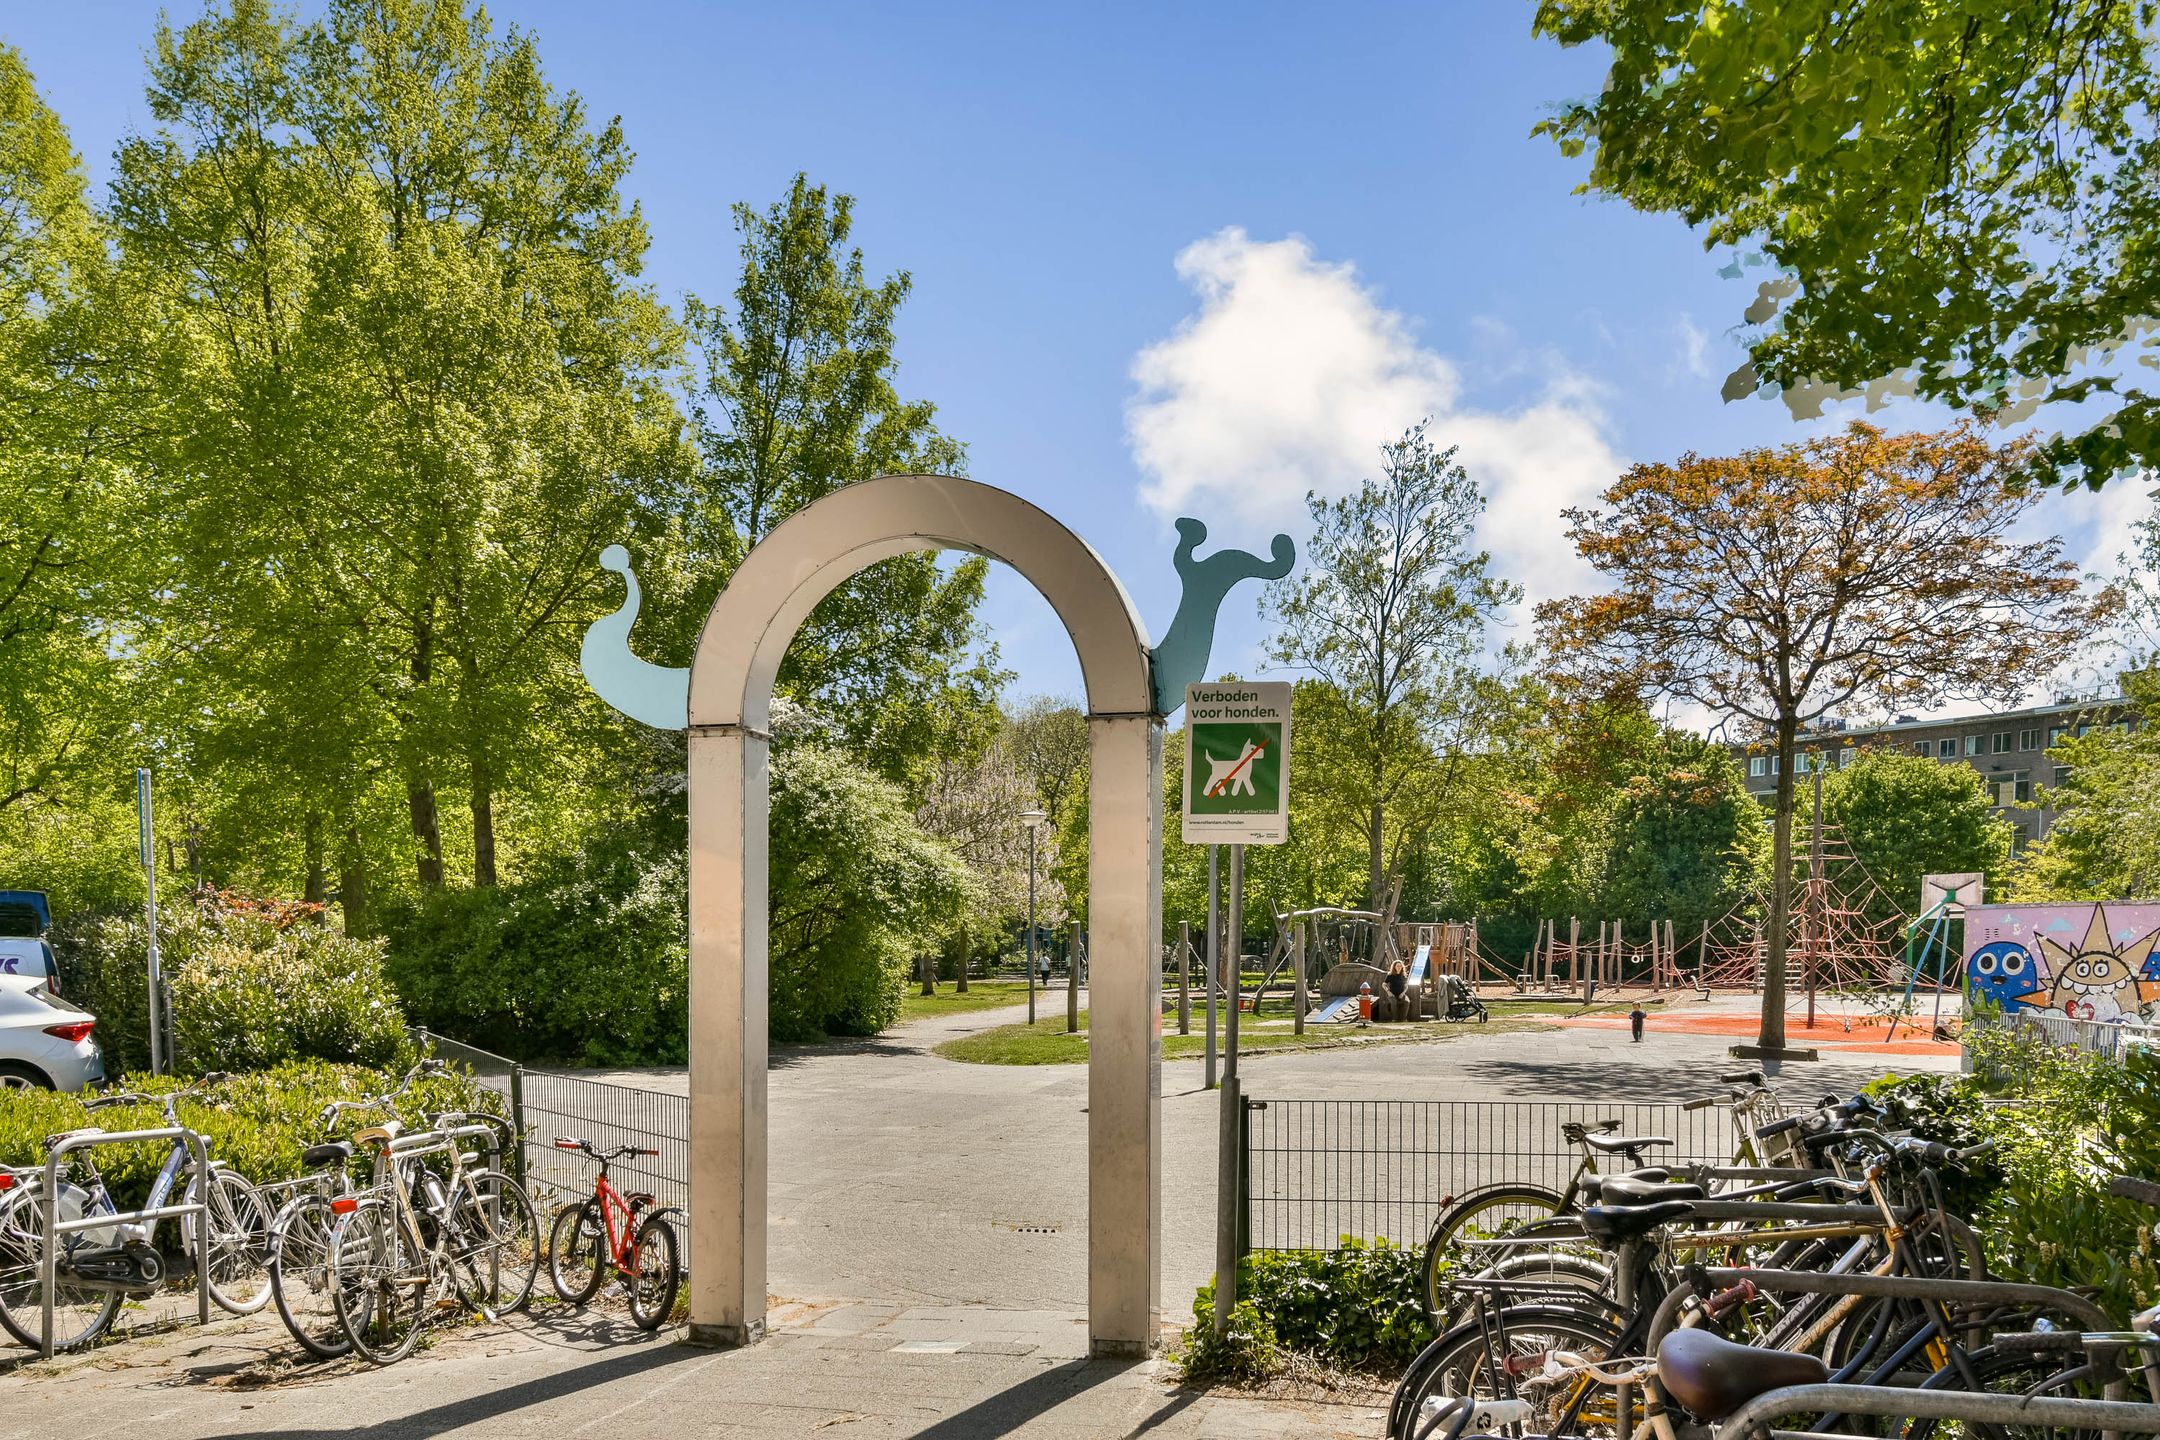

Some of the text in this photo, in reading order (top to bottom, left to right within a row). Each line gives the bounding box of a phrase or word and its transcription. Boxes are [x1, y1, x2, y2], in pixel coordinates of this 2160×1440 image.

[1191, 690, 1258, 702] Verboden
[1191, 706, 1279, 718] voor honden.
[1766, 1291, 1819, 1344] BATAVU
